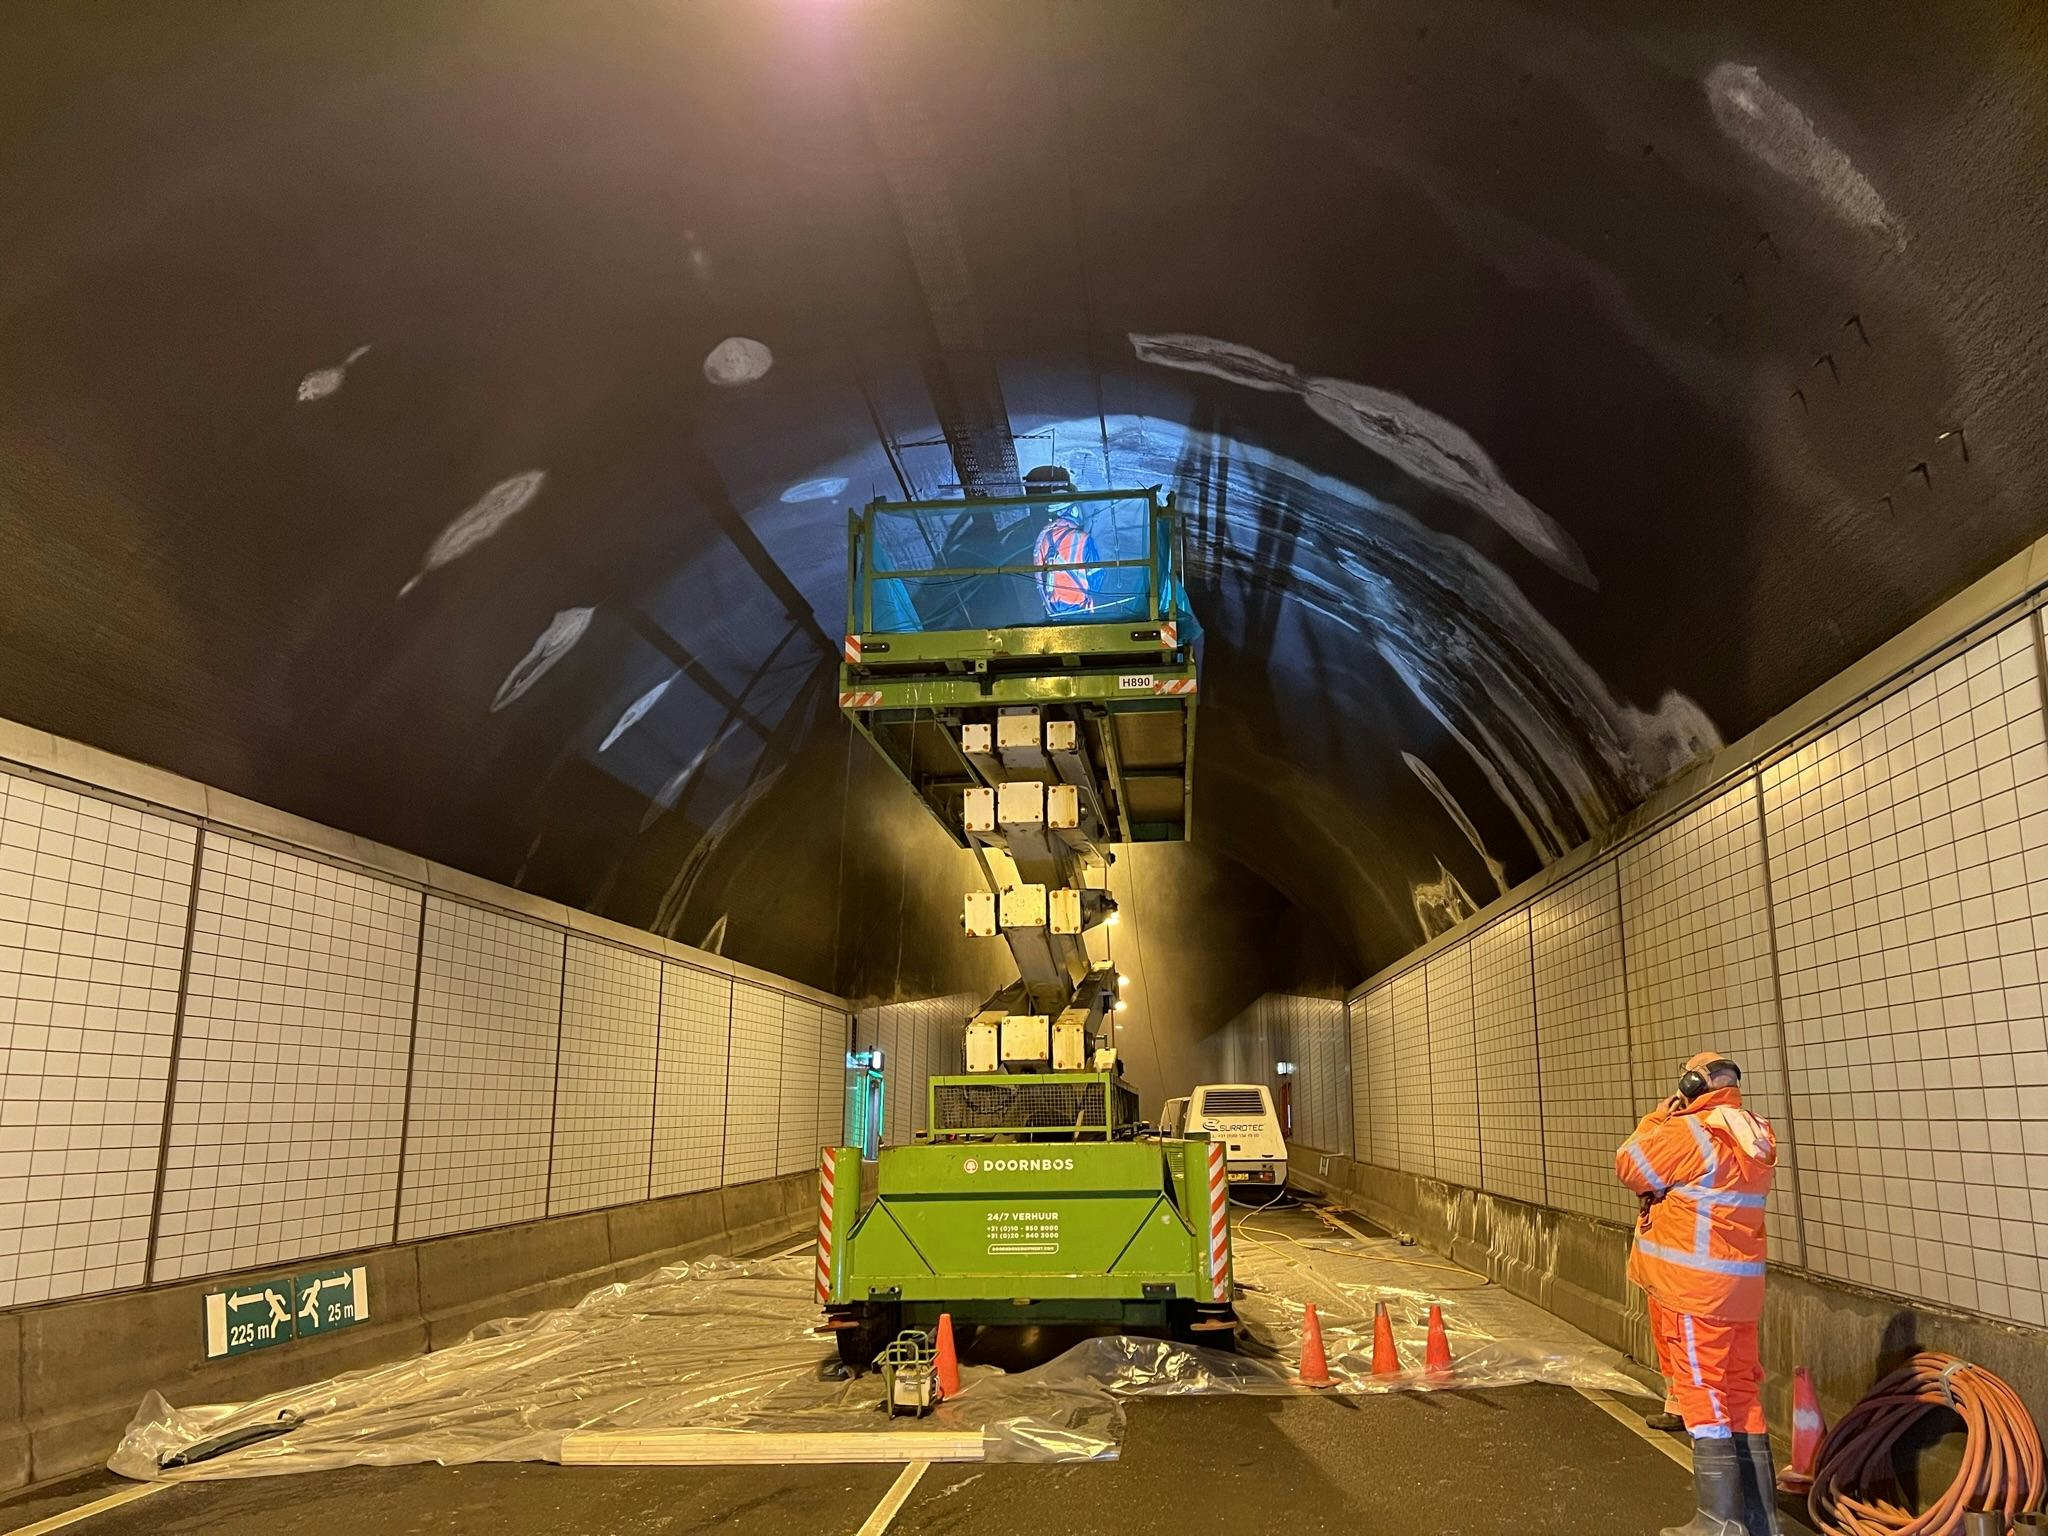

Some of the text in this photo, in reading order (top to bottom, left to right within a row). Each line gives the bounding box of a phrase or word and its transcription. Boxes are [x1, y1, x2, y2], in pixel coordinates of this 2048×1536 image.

[1122, 677, 1151, 687] H890
[983, 1159, 1074, 1171] DOORNBOS
[987, 1212, 1058, 1222] 24/7 VERHUUR
[327, 1303, 355, 1322] 25 m
[230, 1323, 270, 1346] 225 m
